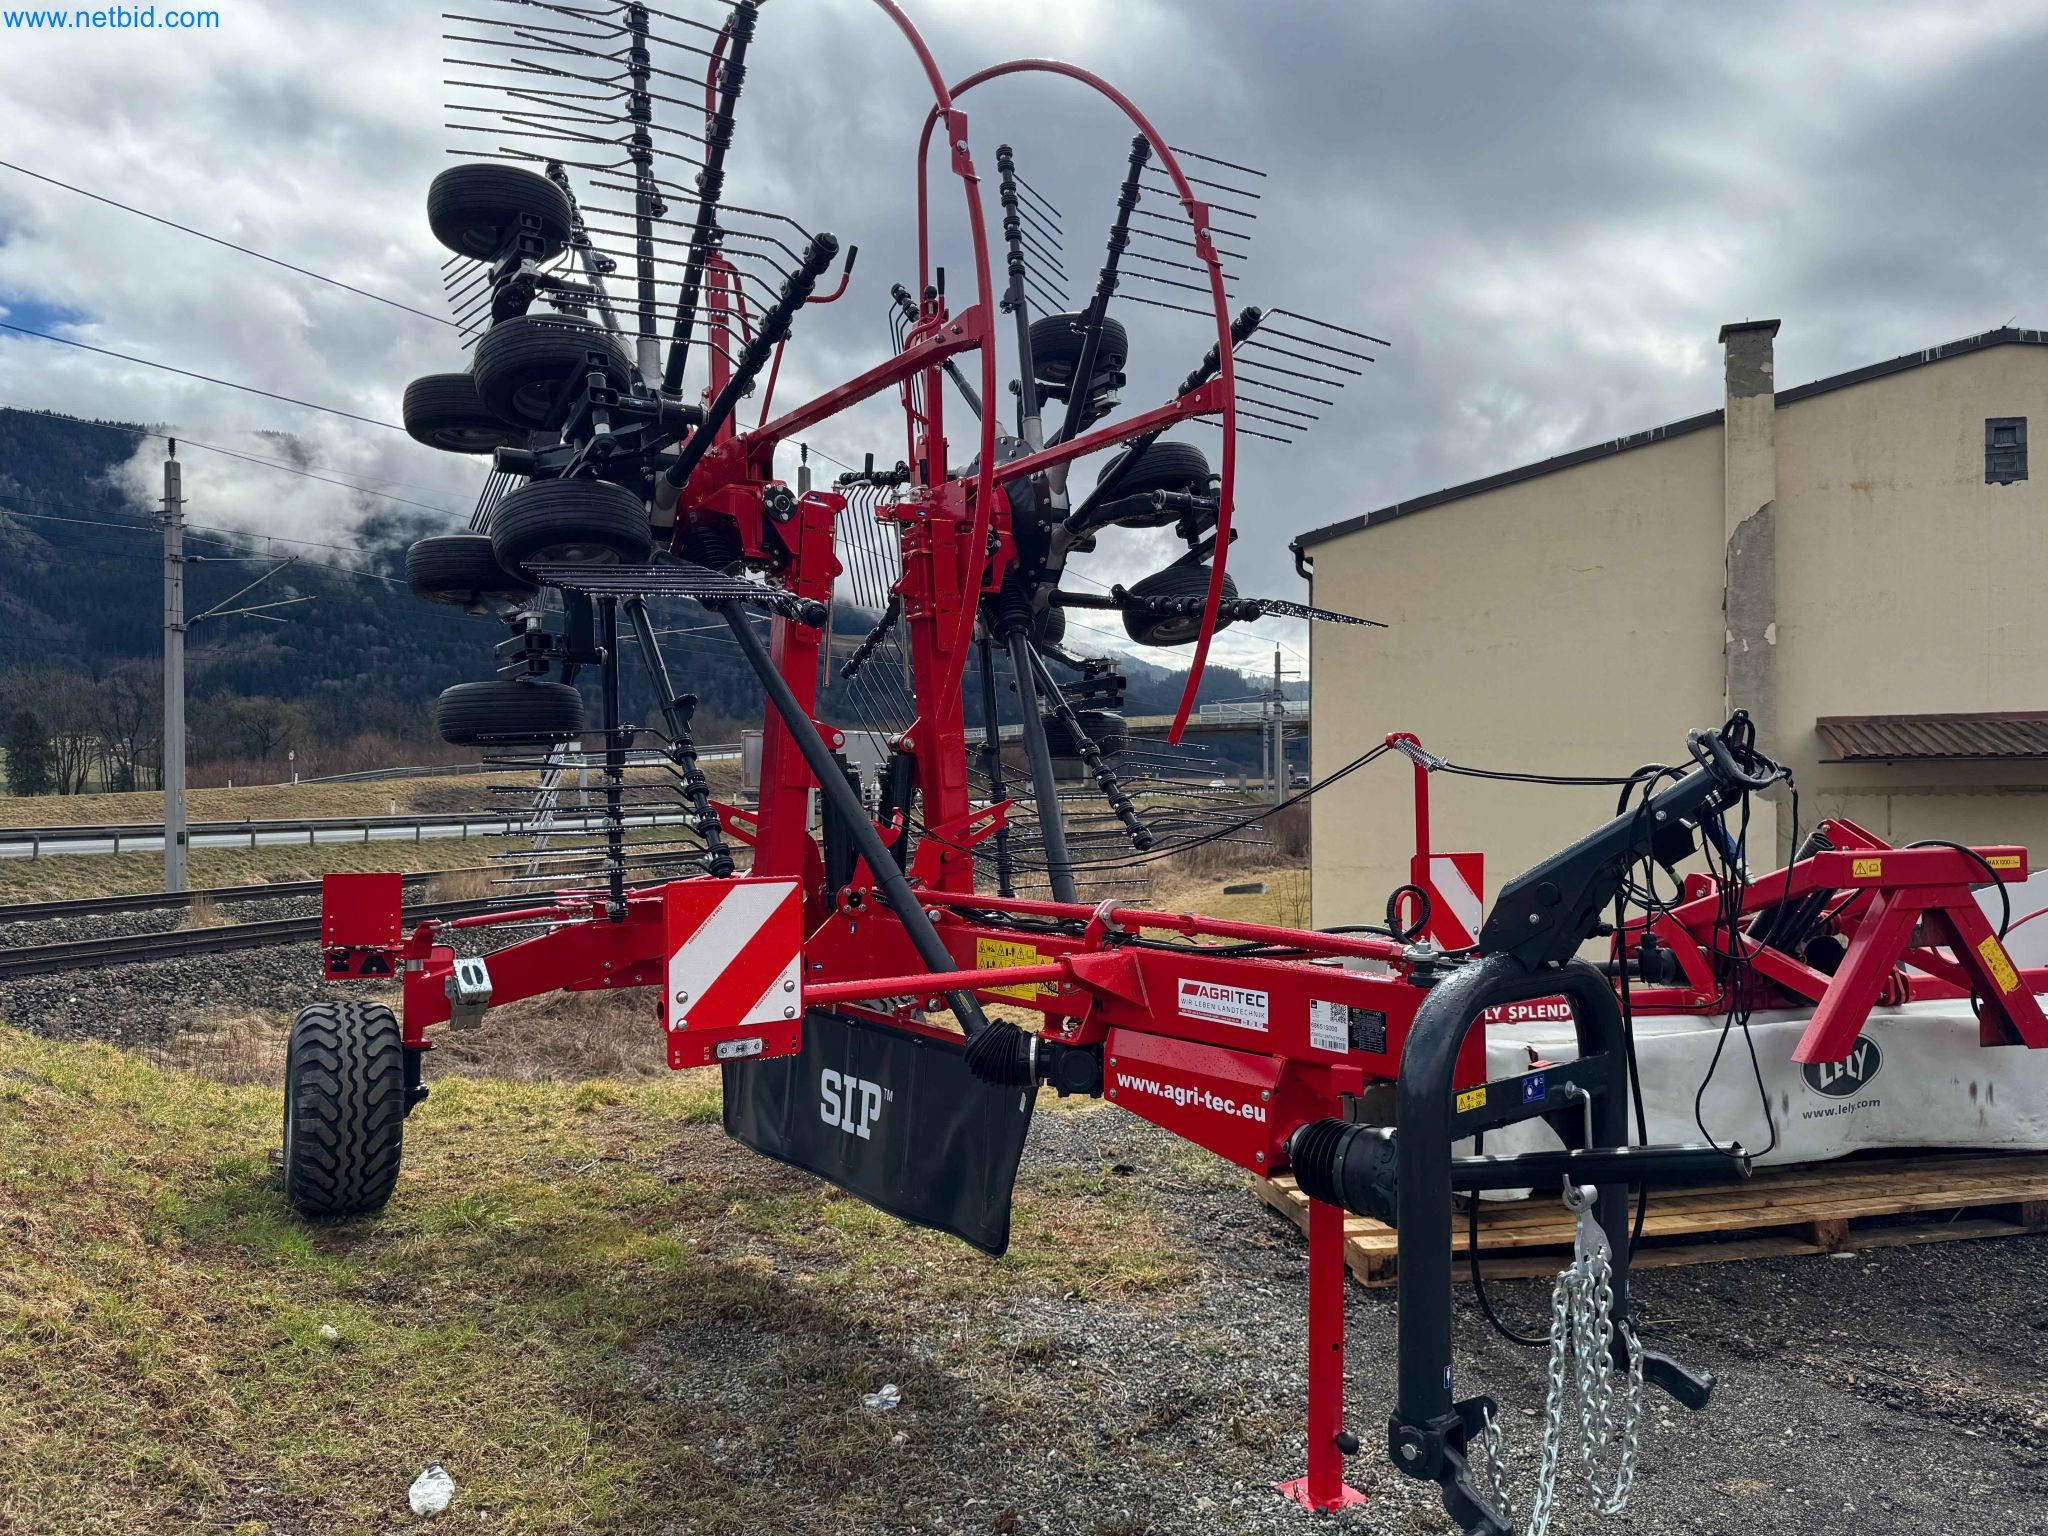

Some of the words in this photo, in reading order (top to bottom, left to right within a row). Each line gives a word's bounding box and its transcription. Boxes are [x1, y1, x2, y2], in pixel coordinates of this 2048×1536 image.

[1181, 998, 1193, 1006] WIR
[1195, 1000, 1216, 1010] LEBEN
[1218, 1005, 1265, 1019] LANDTECHNIK
[1199, 986, 1265, 1007] AGRITEC
[1819, 1042, 1868, 1089] LELY
[820, 1068, 882, 1140] SIP
[1116, 1072, 1267, 1123] www.agri-tec.eu
[1802, 1099, 1881, 1119] www.lely.com
